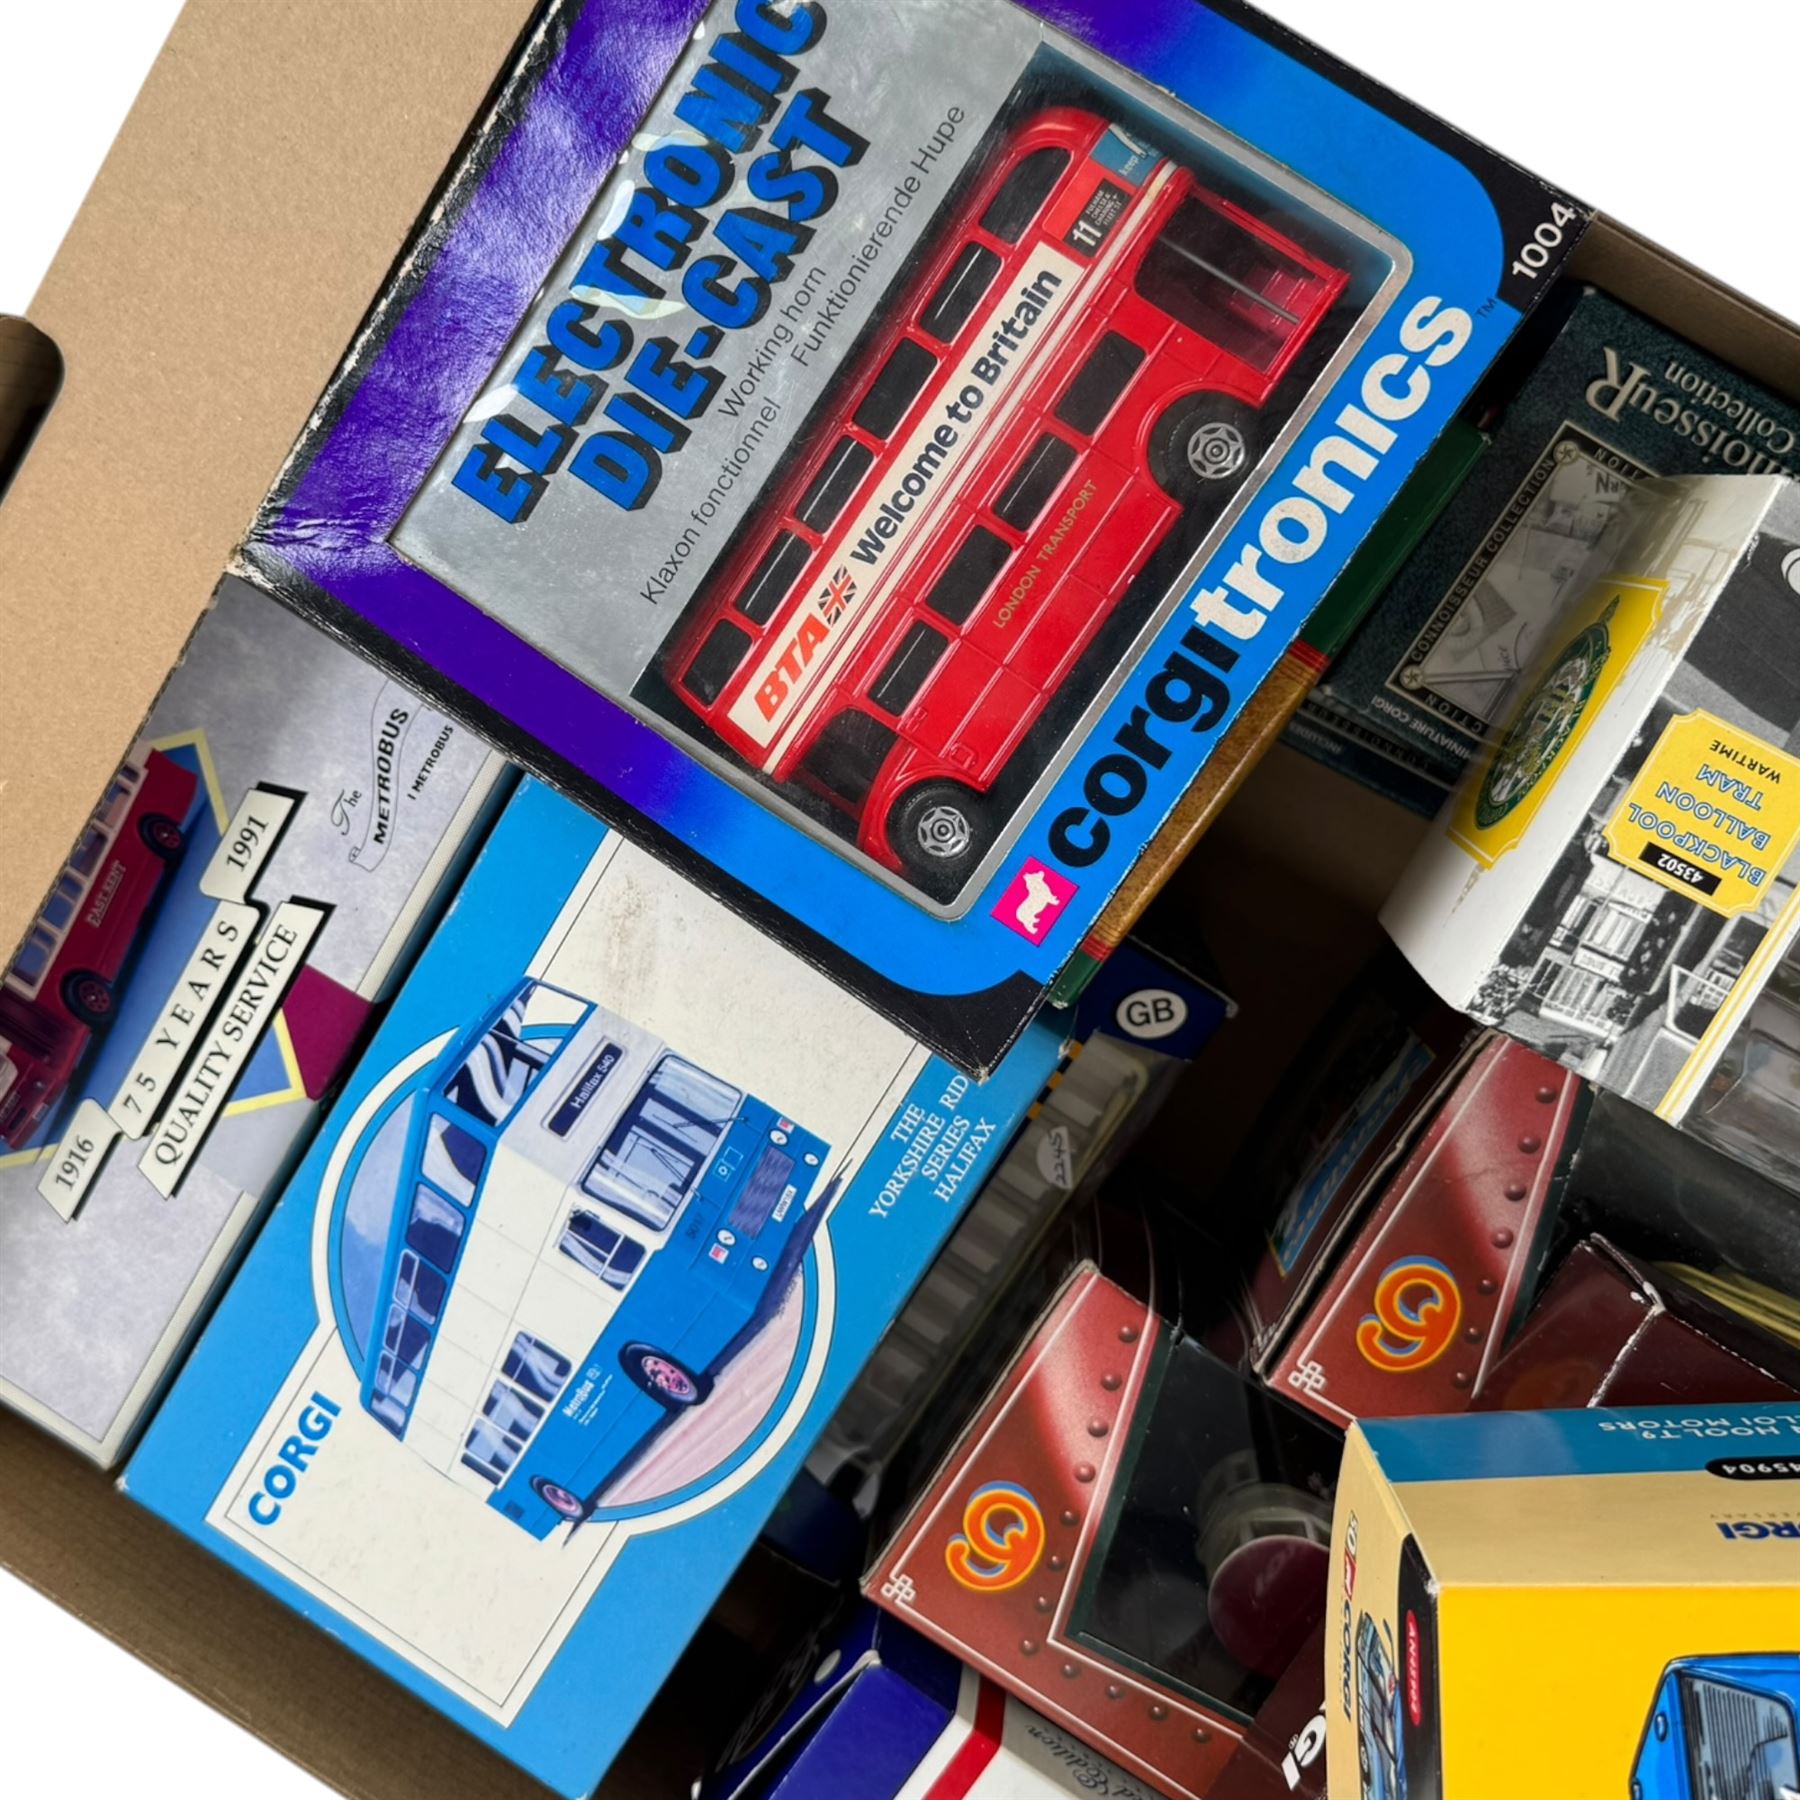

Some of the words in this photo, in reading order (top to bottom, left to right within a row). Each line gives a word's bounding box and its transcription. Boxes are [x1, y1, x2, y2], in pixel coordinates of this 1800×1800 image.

[790, 177, 921, 368] Funktionierende
[911, 104, 965, 175] Hupe
[1072, 220, 1102, 246] 11
[1511, 201, 1578, 281] 1004
[569, 87, 870, 511] DIE-CAST
[718, 323, 793, 418] Working
[780, 266, 827, 322] horn
[1664, 360, 1795, 454] Collection
[640, 527, 701, 605] Klaxon
[691, 396, 781, 525] fonctionnel
[754, 611, 832, 724] BTA
[850, 420, 958, 566] Welcome
[946, 384, 984, 423] to
[971, 269, 1062, 386] Britain
[992, 564, 1041, 629] LONDON
[1036, 479, 1096, 562] TRANSPORT
[1411, 556, 1487, 663] CONNOISSEUR
[1485, 458, 1554, 553] COLLECTION
[1371, 695, 1409, 722] CORGI
[1425, 693, 1483, 734] CTION
[373, 705, 410, 845] METROBUS
[412, 725, 454, 793] METROBUS
[1696, 764, 1764, 811] TRAM
[1710, 739, 1781, 784] WARTIME
[226, 813, 269, 874] 1991
[331, 788, 362, 836] The
[1628, 802, 1767, 886] BLACKPOOL
[1655, 781, 1771, 851] BALLOON
[1657, 853, 1704, 884] 43502
[155, 917, 240, 1052] YEARS
[1126, 997, 1175, 1027] GB
[155, 1038, 231, 1166] QUALITY
[222, 924, 298, 1043] SERVICE
[570, 1069, 604, 1110] Halifax
[890, 1103, 925, 1144] THE
[55, 1137, 95, 1190] 1916
[868, 1113, 945, 1219] YORKSHIRE
[939, 1074, 970, 1110] RID
[921, 1115, 970, 1181] SERIES
[933, 1117, 997, 1203] HALIFAX
[247, 1391, 342, 1527] CORGI
[1598, 1418, 1731, 1432] MOTORS
[1684, 1426, 1780, 1437] HOOL
[1722, 1461, 1800, 1475] 45904
[1716, 1521, 1800, 1540] RGI
[1026, 1724, 1109, 1796] Edition
